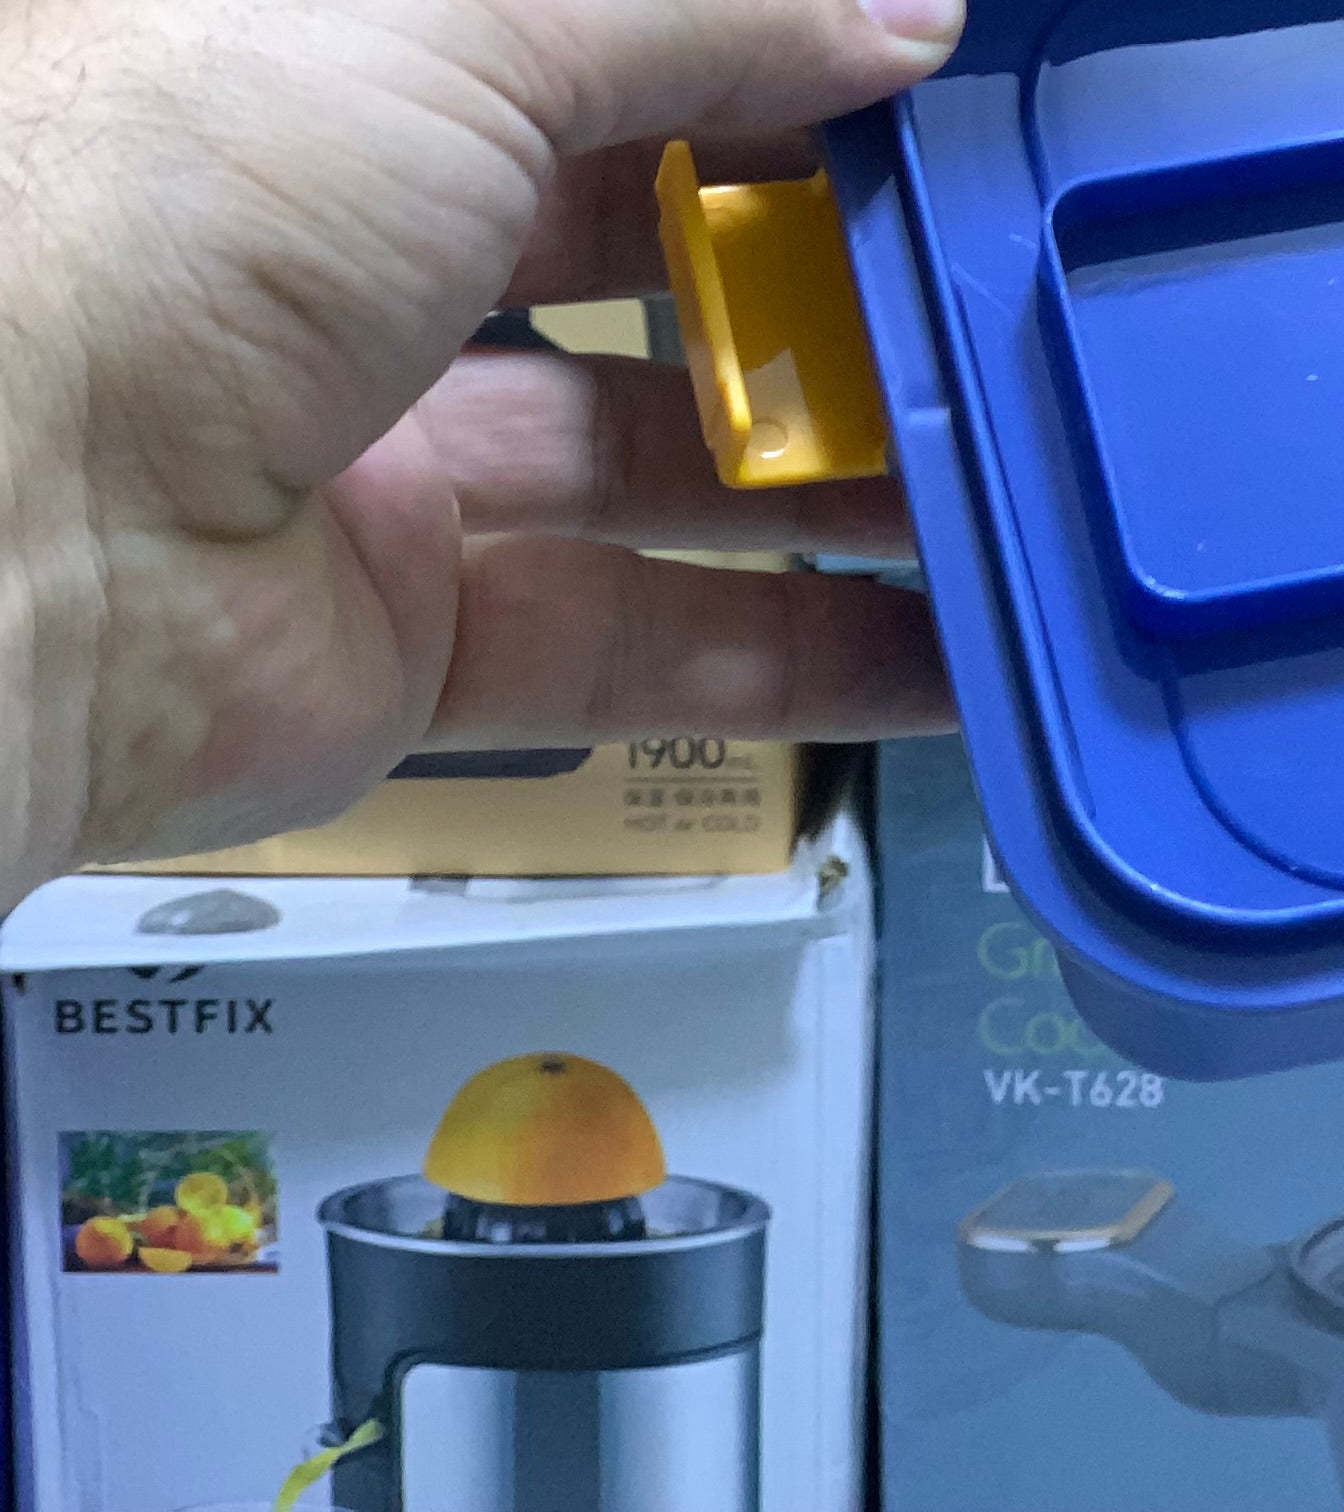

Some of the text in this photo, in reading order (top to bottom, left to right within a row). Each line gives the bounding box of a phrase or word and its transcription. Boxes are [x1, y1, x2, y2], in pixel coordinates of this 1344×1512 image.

[628, 737, 726, 769] 1900
[55, 999, 275, 1035] BESTFIX
[983, 1069, 1165, 1108] VK-T628
